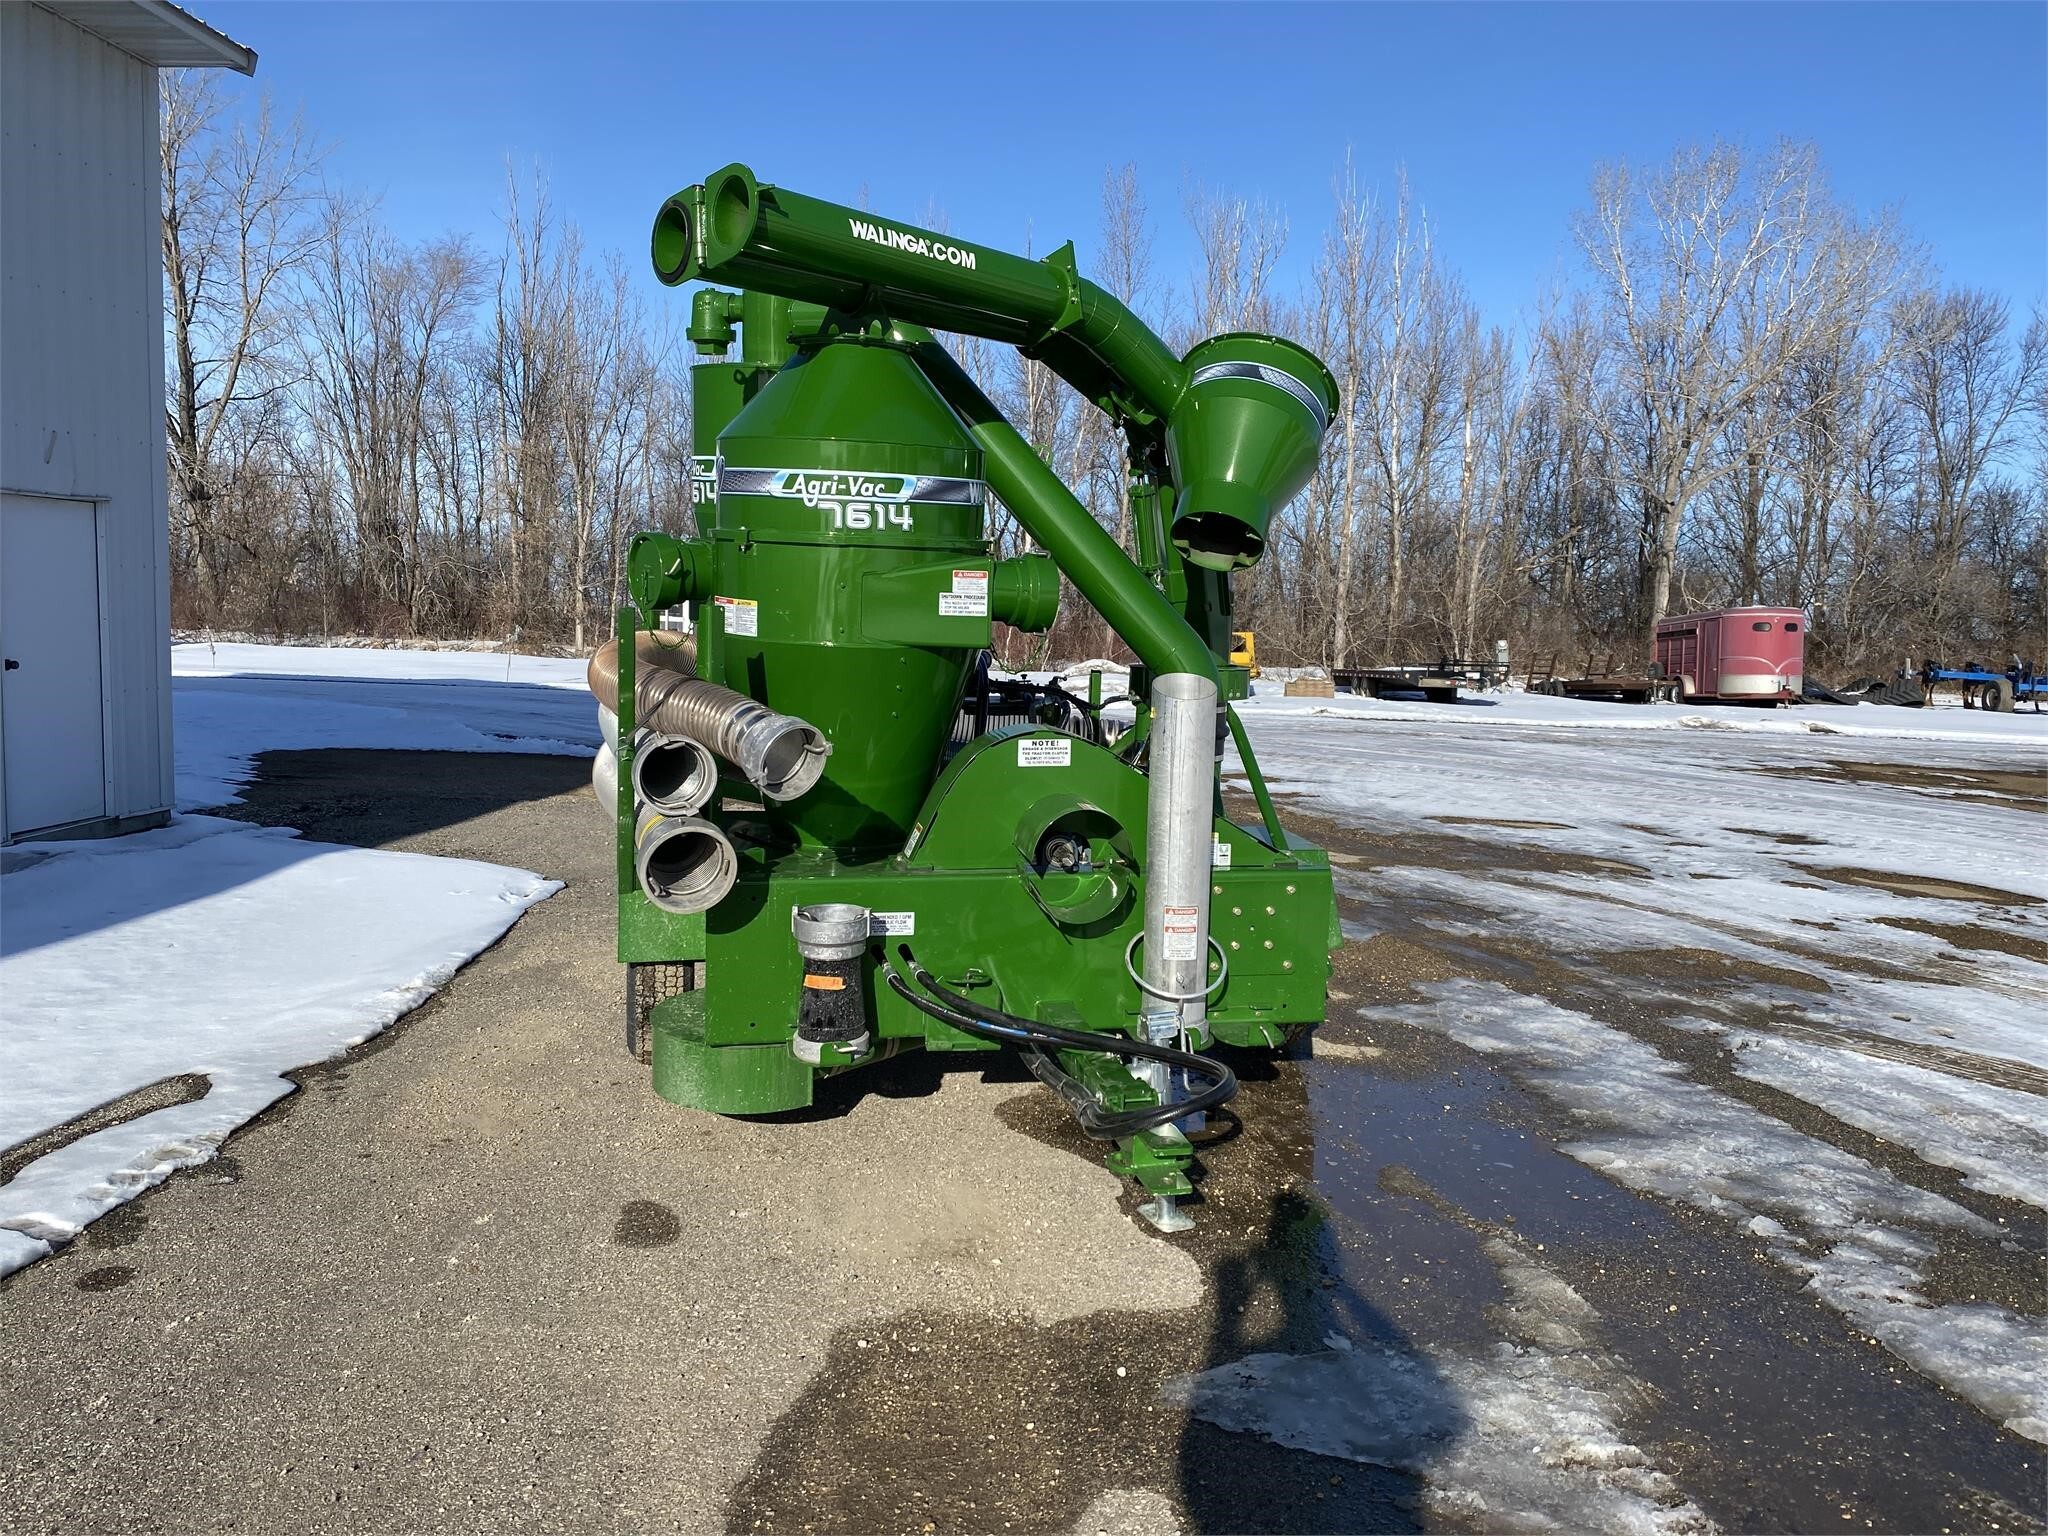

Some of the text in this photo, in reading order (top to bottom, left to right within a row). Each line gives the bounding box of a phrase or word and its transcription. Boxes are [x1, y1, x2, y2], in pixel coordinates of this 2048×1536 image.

[692, 481, 717, 505] 614
[792, 473, 886, 508] Agri-Vac
[817, 501, 914, 532] 7614
